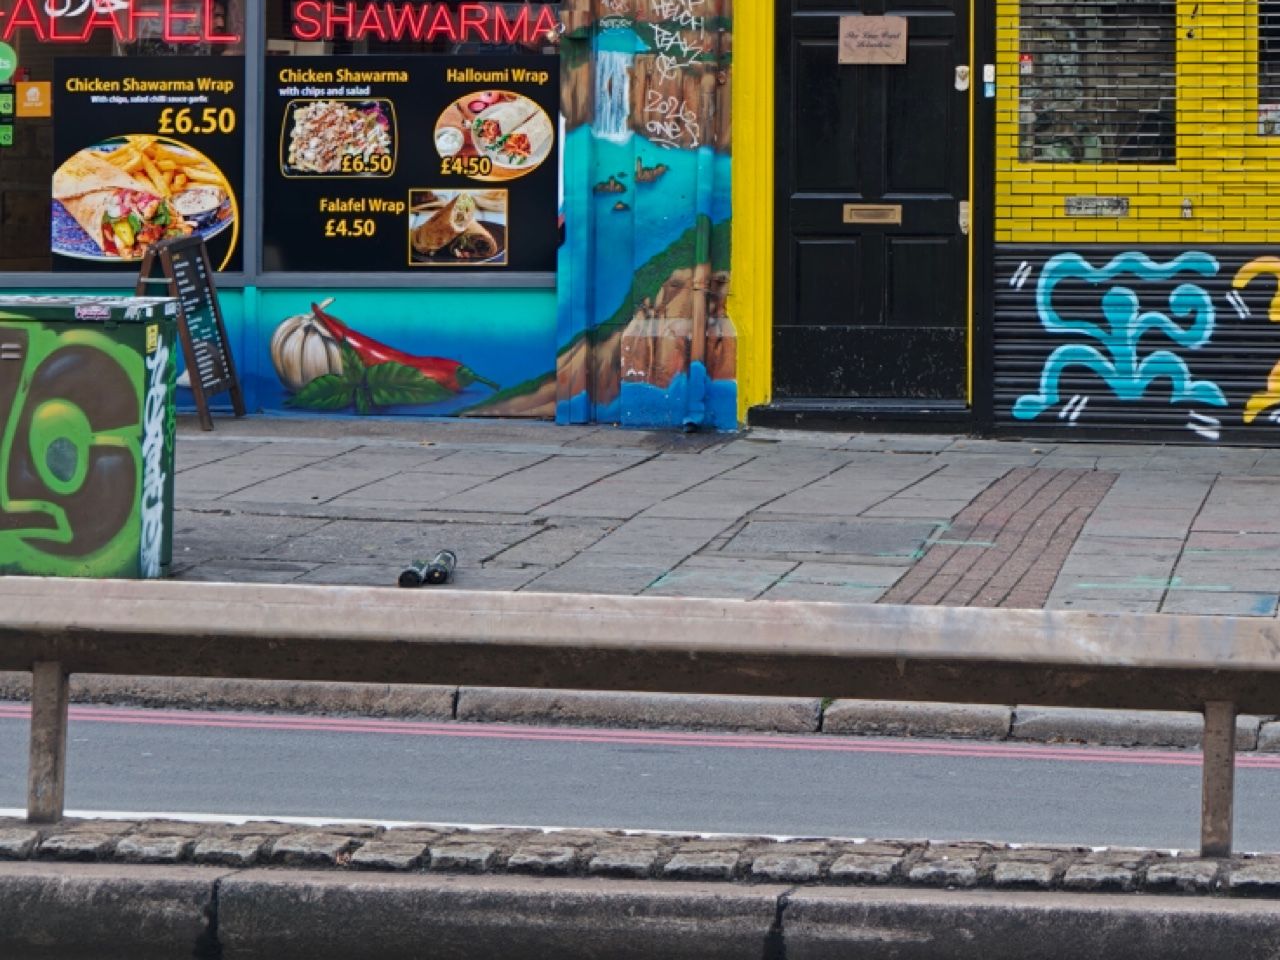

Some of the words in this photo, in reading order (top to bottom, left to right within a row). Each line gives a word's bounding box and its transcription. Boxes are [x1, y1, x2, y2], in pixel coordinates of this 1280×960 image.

[293, 0, 559, 44] SHAWARMA
[279, 68, 333, 84] Chicken
[335, 68, 409, 84] Shawarma
[446, 68, 509, 84] Halloumi
[511, 68, 549, 87] Wrap
[65, 77, 120, 92] Chicken
[122, 77, 194, 92] Shawarma
[197, 77, 234, 95] Wrap
[279, 86, 300, 96] with
[301, 86, 325, 98] chips
[327, 86, 343, 96] and
[346, 86, 370, 96] salad
[158, 107, 236, 134] £6.50
[341, 155, 392, 173] £6.50
[440, 157, 491, 175] £4.50
[320, 198, 366, 213] Falafel
[368, 198, 405, 216] Wrap
[324, 218, 377, 237] £4.50
